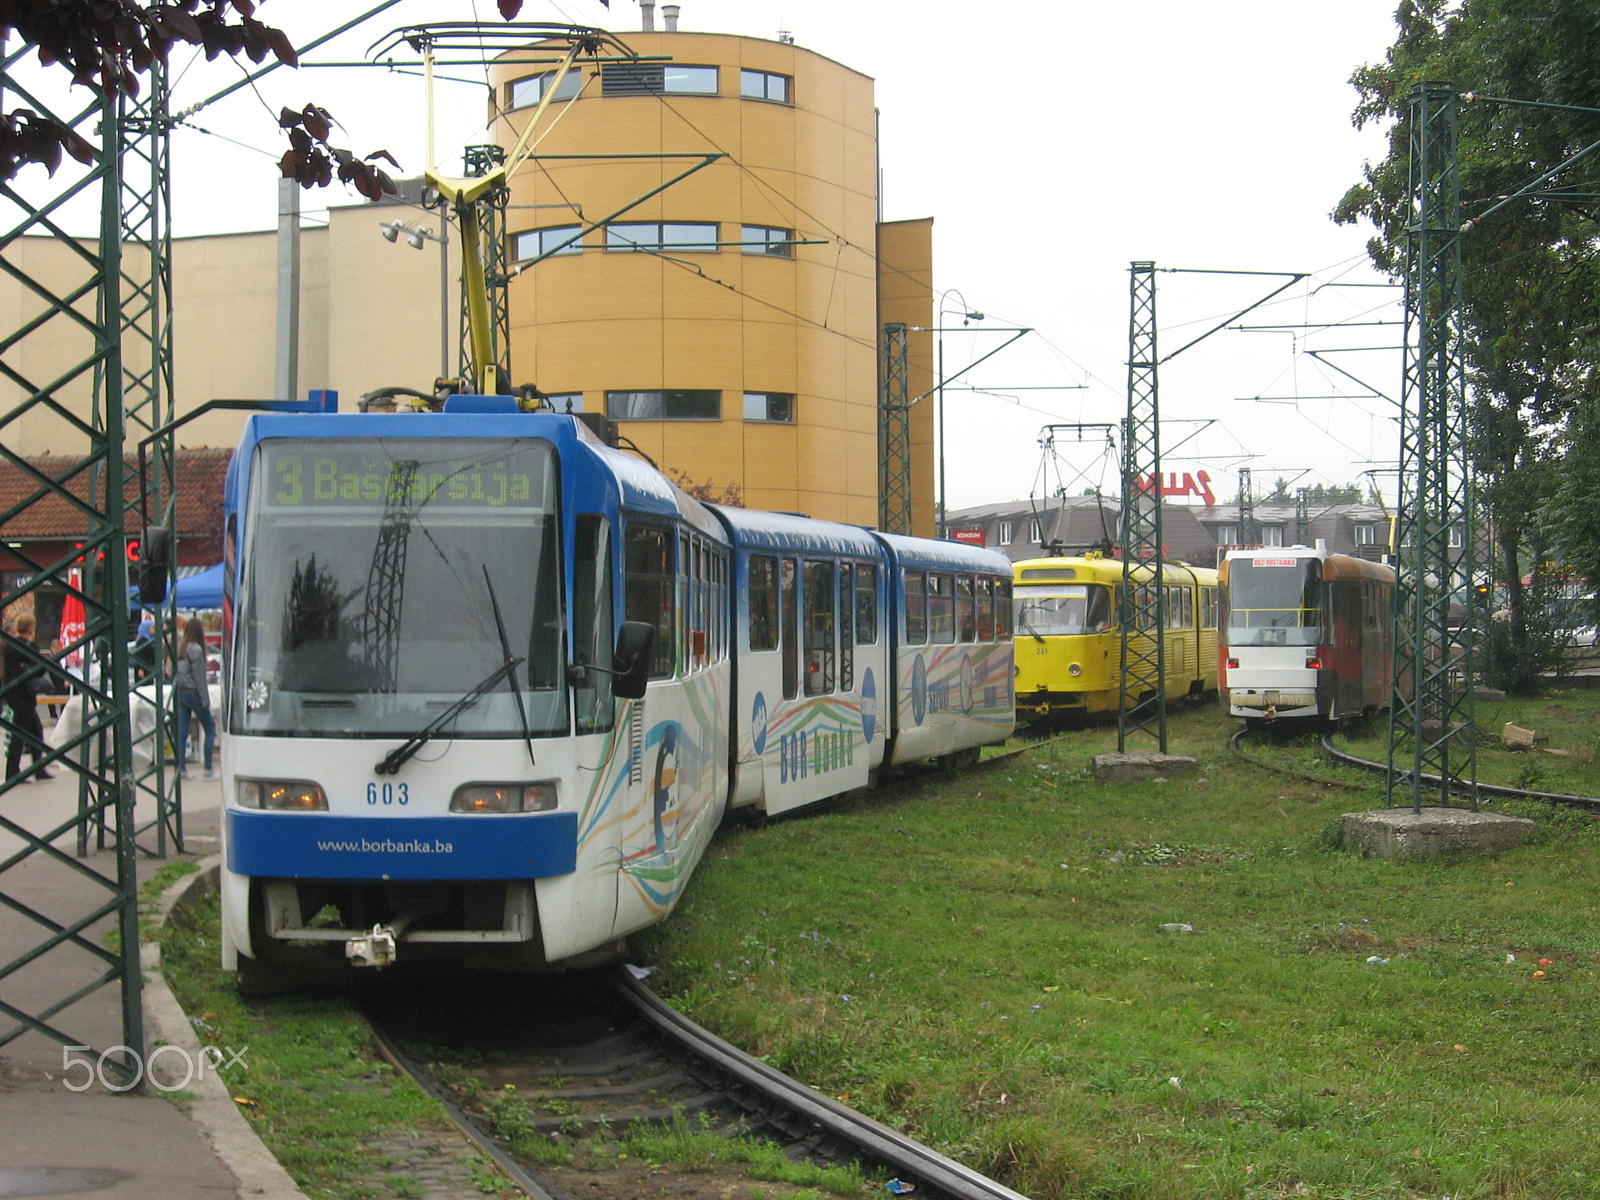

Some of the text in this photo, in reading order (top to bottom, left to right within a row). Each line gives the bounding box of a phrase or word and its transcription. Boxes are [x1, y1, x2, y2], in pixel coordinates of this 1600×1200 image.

[276, 456, 302, 504] 3
[780, 723, 853, 785] BOR banka
[366, 782, 409, 805] 603
[317, 838, 453, 853] www.borbanka.ba
